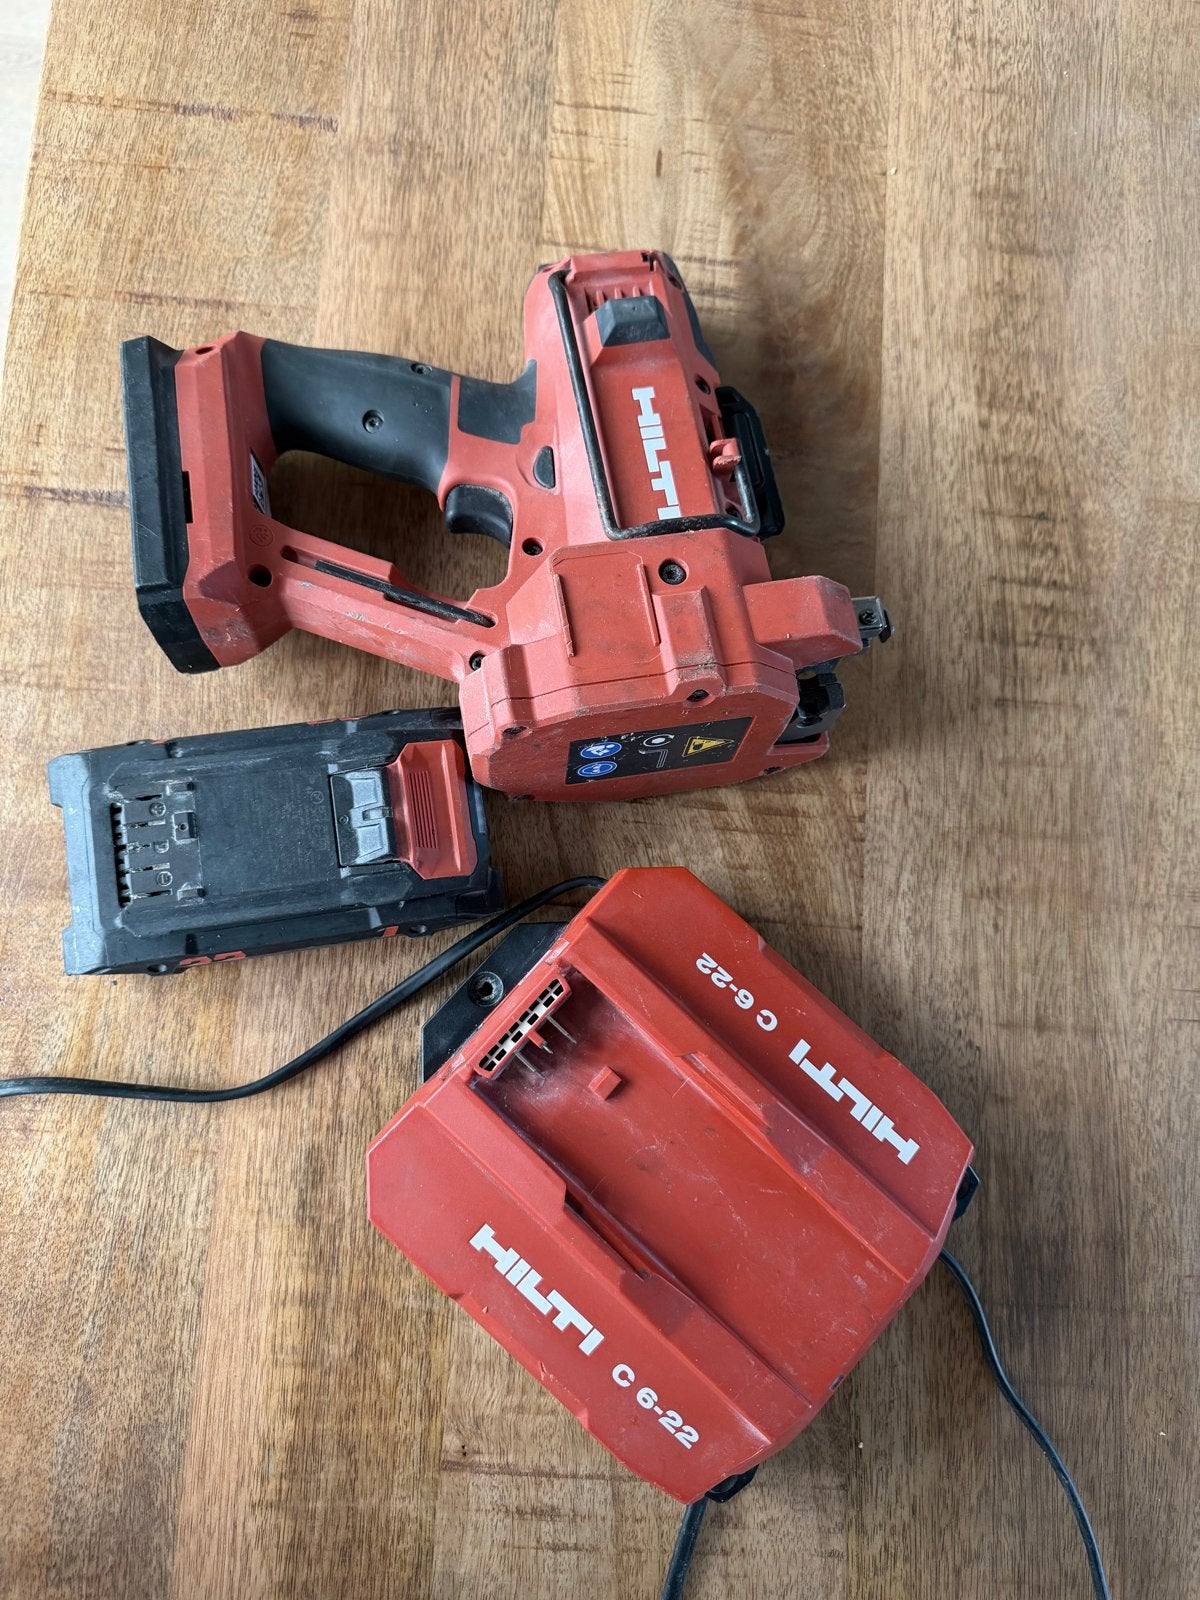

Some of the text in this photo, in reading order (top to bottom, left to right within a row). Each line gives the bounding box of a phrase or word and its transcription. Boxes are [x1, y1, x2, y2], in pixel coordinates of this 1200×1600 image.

[632, 386, 681, 521] HILTI
[695, 952, 920, 1165] HILTI C 6-22
[469, 1224, 700, 1450] HILTI C 6-22
